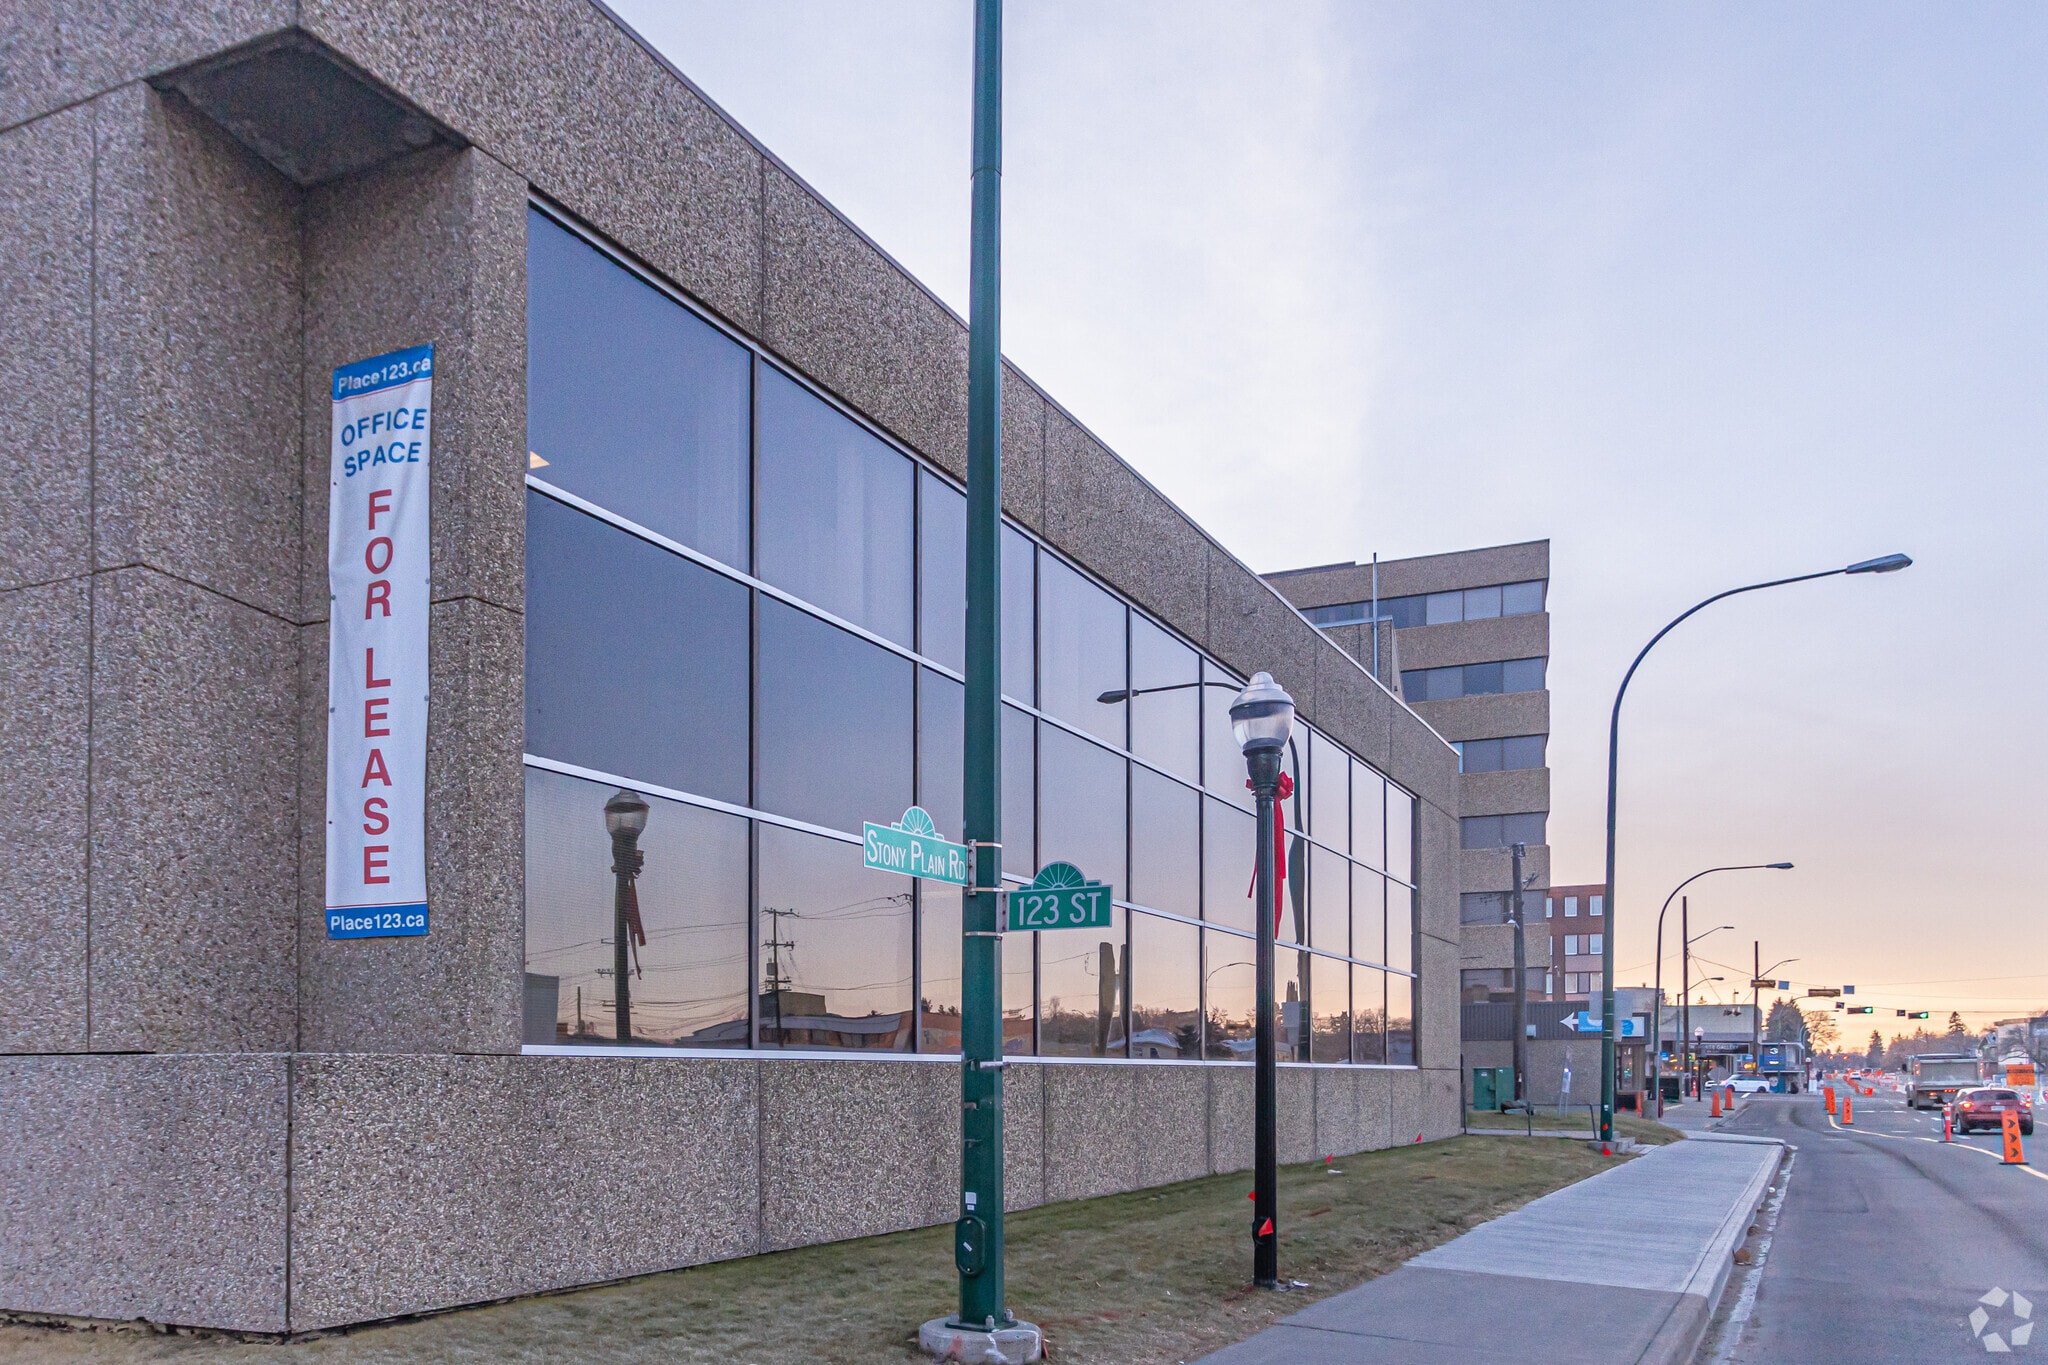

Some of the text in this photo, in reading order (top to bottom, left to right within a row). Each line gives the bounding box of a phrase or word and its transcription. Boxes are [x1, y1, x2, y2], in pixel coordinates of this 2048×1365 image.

[338, 357, 432, 394] Place123.ca
[341, 407, 428, 446] OFFICE
[344, 441, 422, 478] SPACE
[361, 489, 394, 885] FOR LEASE
[330, 913, 425, 931] Place123.ca
[1018, 892, 1102, 926] 123 ST
